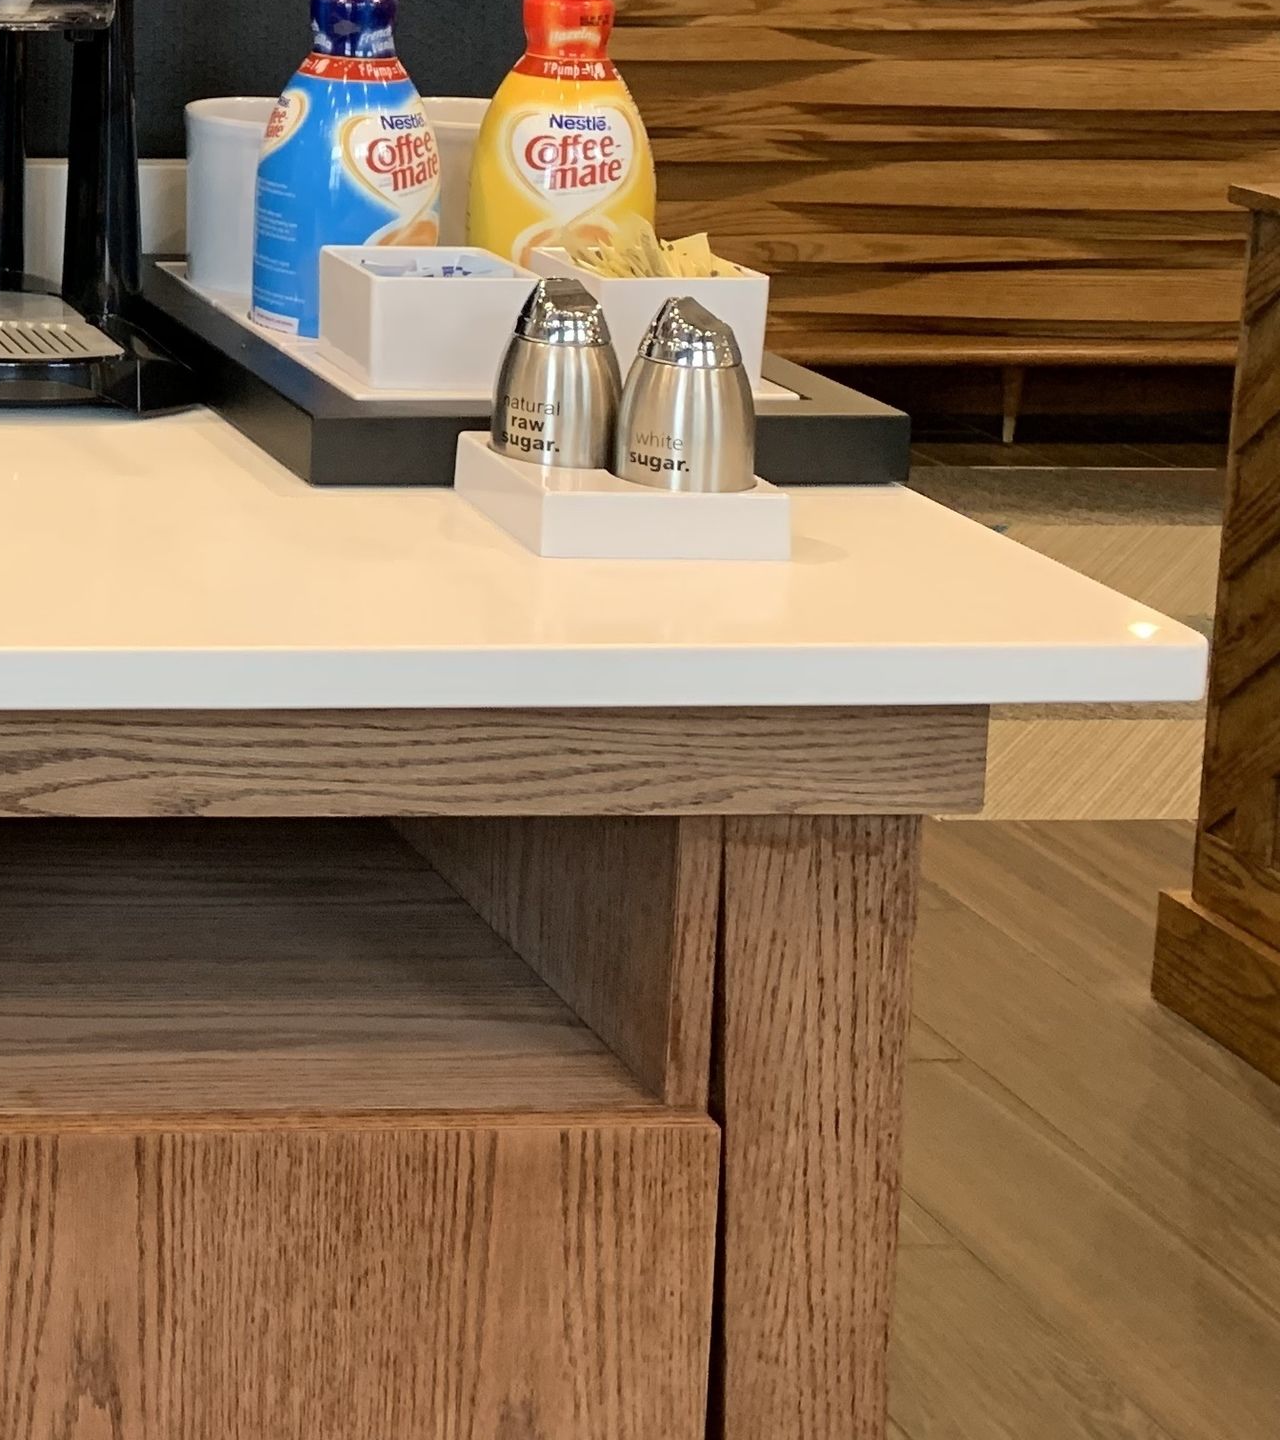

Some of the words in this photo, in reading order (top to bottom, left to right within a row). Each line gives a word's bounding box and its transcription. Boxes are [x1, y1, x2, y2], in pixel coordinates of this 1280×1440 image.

[551, 62, 580, 79] Pump
[392, 152, 439, 191] mate
[549, 158, 622, 190] mate
[504, 394, 561, 416] natural
[511, 415, 545, 432] raw
[501, 430, 561, 453] sugar.
[635, 431, 684, 451] white
[629, 451, 690, 472] sugar.
